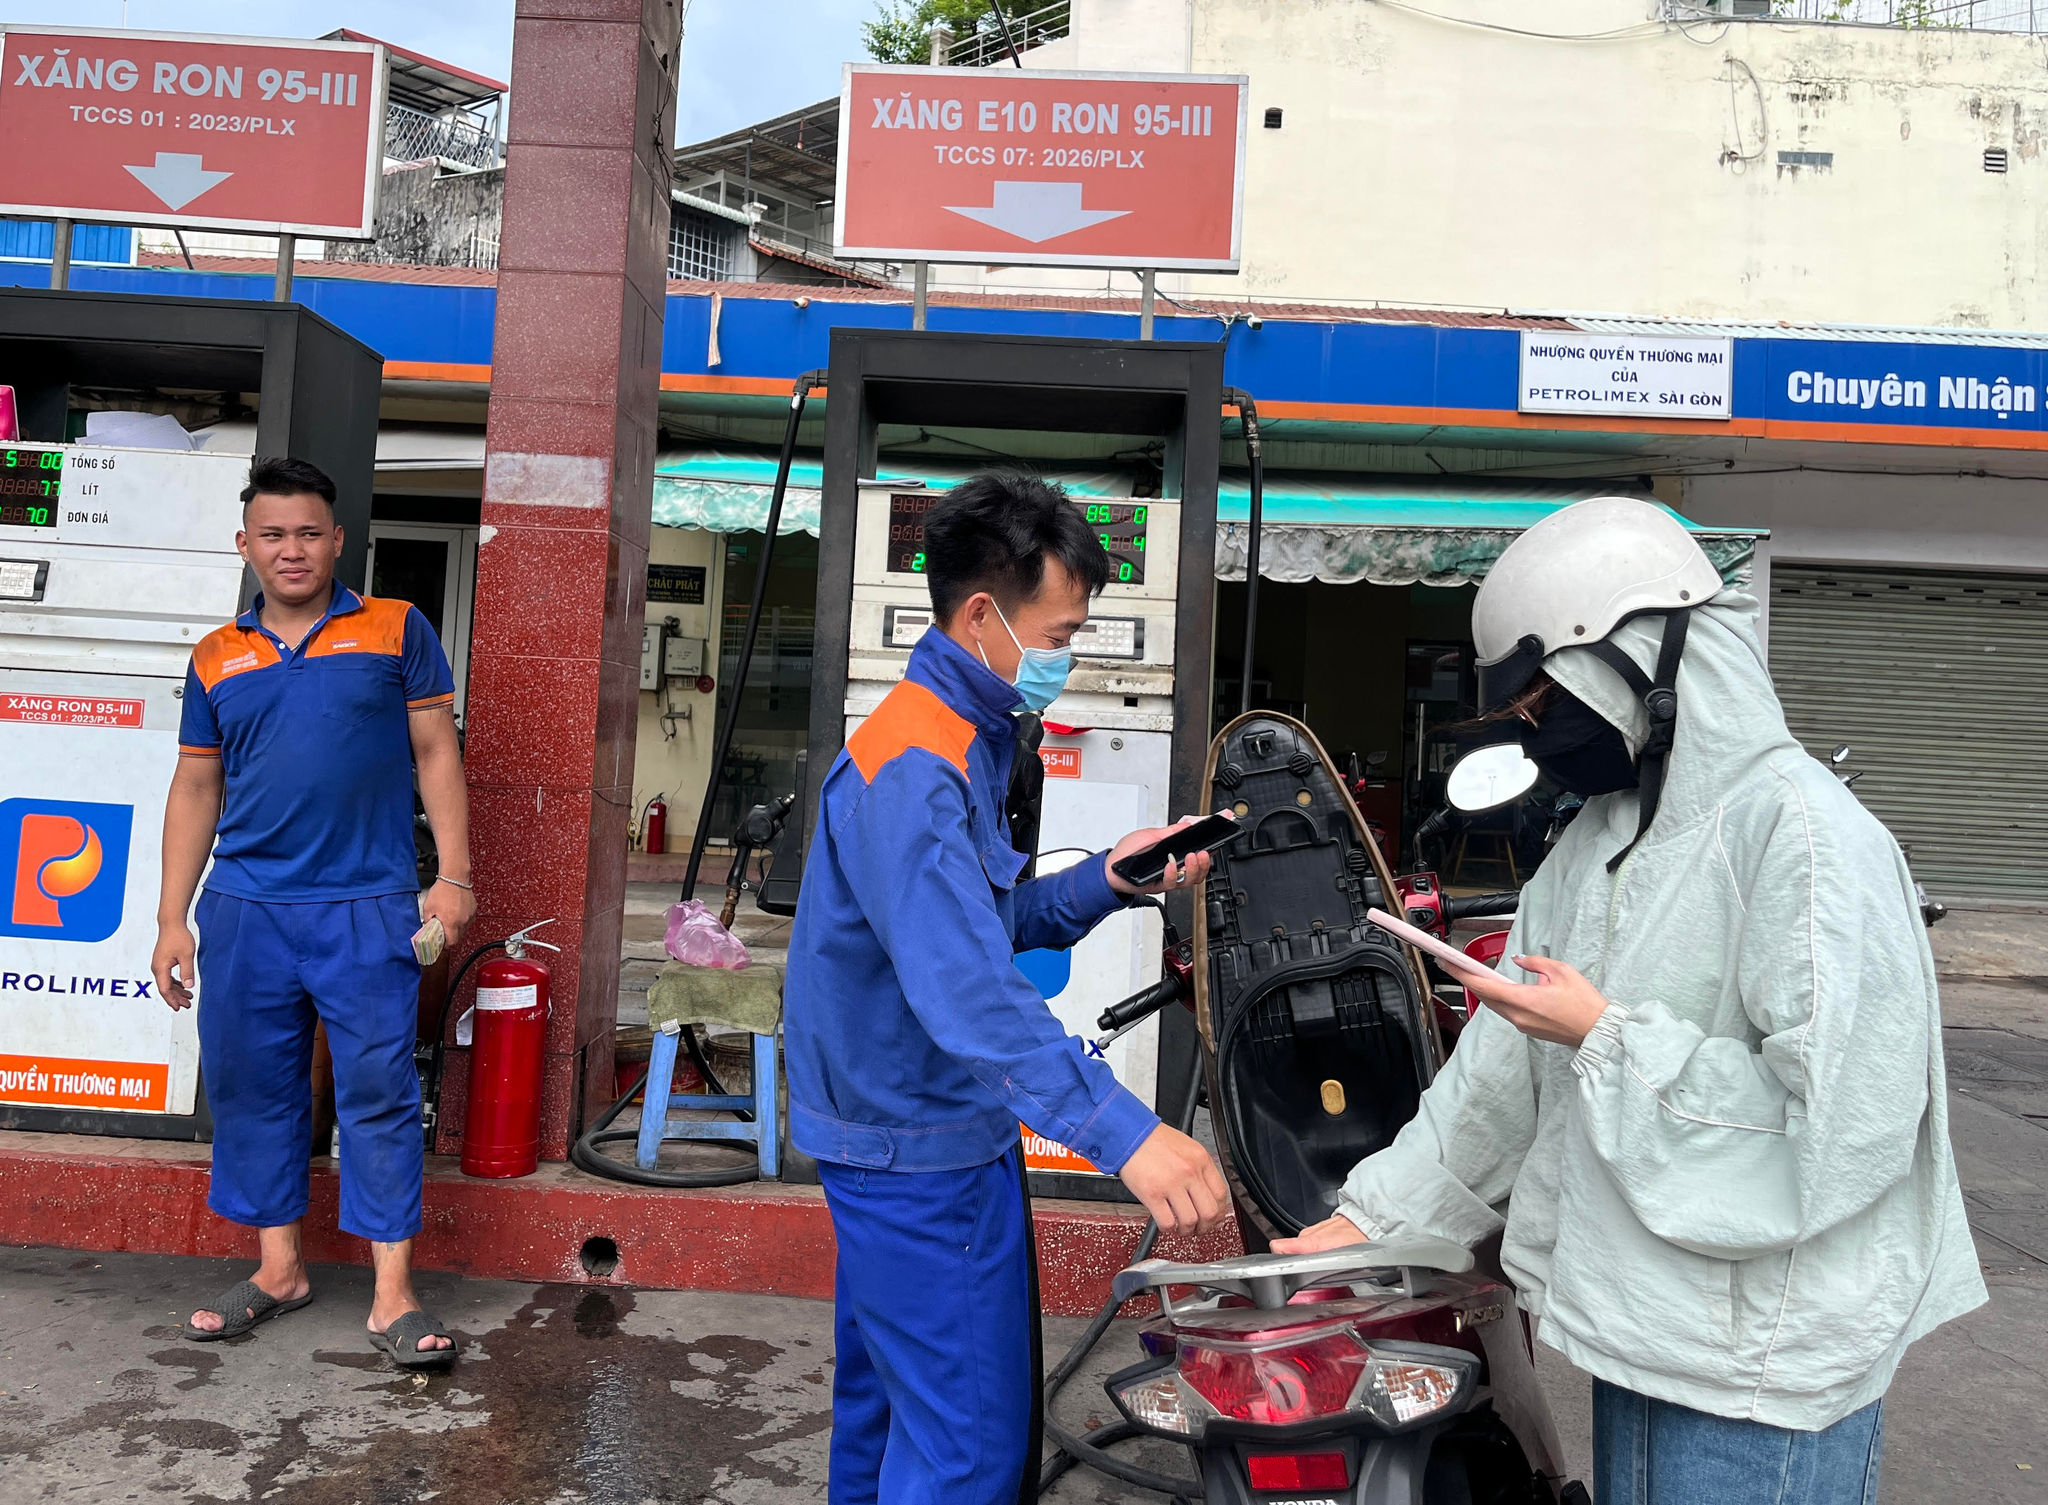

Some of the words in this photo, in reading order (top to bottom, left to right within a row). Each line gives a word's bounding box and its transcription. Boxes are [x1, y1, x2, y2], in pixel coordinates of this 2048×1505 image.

[14, 48, 139, 92] XĂNG
[153, 62, 243, 98] RON
[257, 68, 357, 106] 95-III
[70, 106, 133, 125] TCCS
[141, 110, 164, 126] 01
[189, 113, 296, 136] 2023/PLX
[871, 91, 963, 131] XĂNG
[978, 101, 1037, 133] E10
[1052, 102, 1119, 134] RON
[1134, 104, 1212, 136] 95-III
[934, 145, 996, 165] TCCS
[1042, 148, 1145, 168] 2026/PLX
[1530, 344, 1585, 361] NHƯỢNG
[1589, 345, 1635, 361] QUYỀN
[1639, 349, 1693, 363] THƯƠNG
[1697, 352, 1723, 366] MẠI
[1611, 366, 1638, 383] CỦA
[1529, 388, 1650, 403] PETROLIMEX
[1659, 390, 1684, 404] SÀI
[1690, 391, 1722, 406] GÒN
[1787, 370, 1926, 410] Chuyên
[1939, 375, 2035, 420] Nhận
[101, 455, 116, 470] SỐ
[82, 482, 99, 496] LÍT
[67, 511, 89, 523] ĐƠN
[92, 510, 109, 524] GIÁ
[8, 696, 53, 710] XĂNG
[57, 700, 92, 713] RON
[96, 702, 133, 716] 95-III
[20, 711, 49, 720] TCCS
[51, 713, 62, 721] 01
[71, 714, 118, 725] 2023/PLX
[2, 971, 153, 999] ROLIMEX
[53, 1071, 116, 1096] THƯƠNG
[120, 1077, 150, 1101] MẠI
